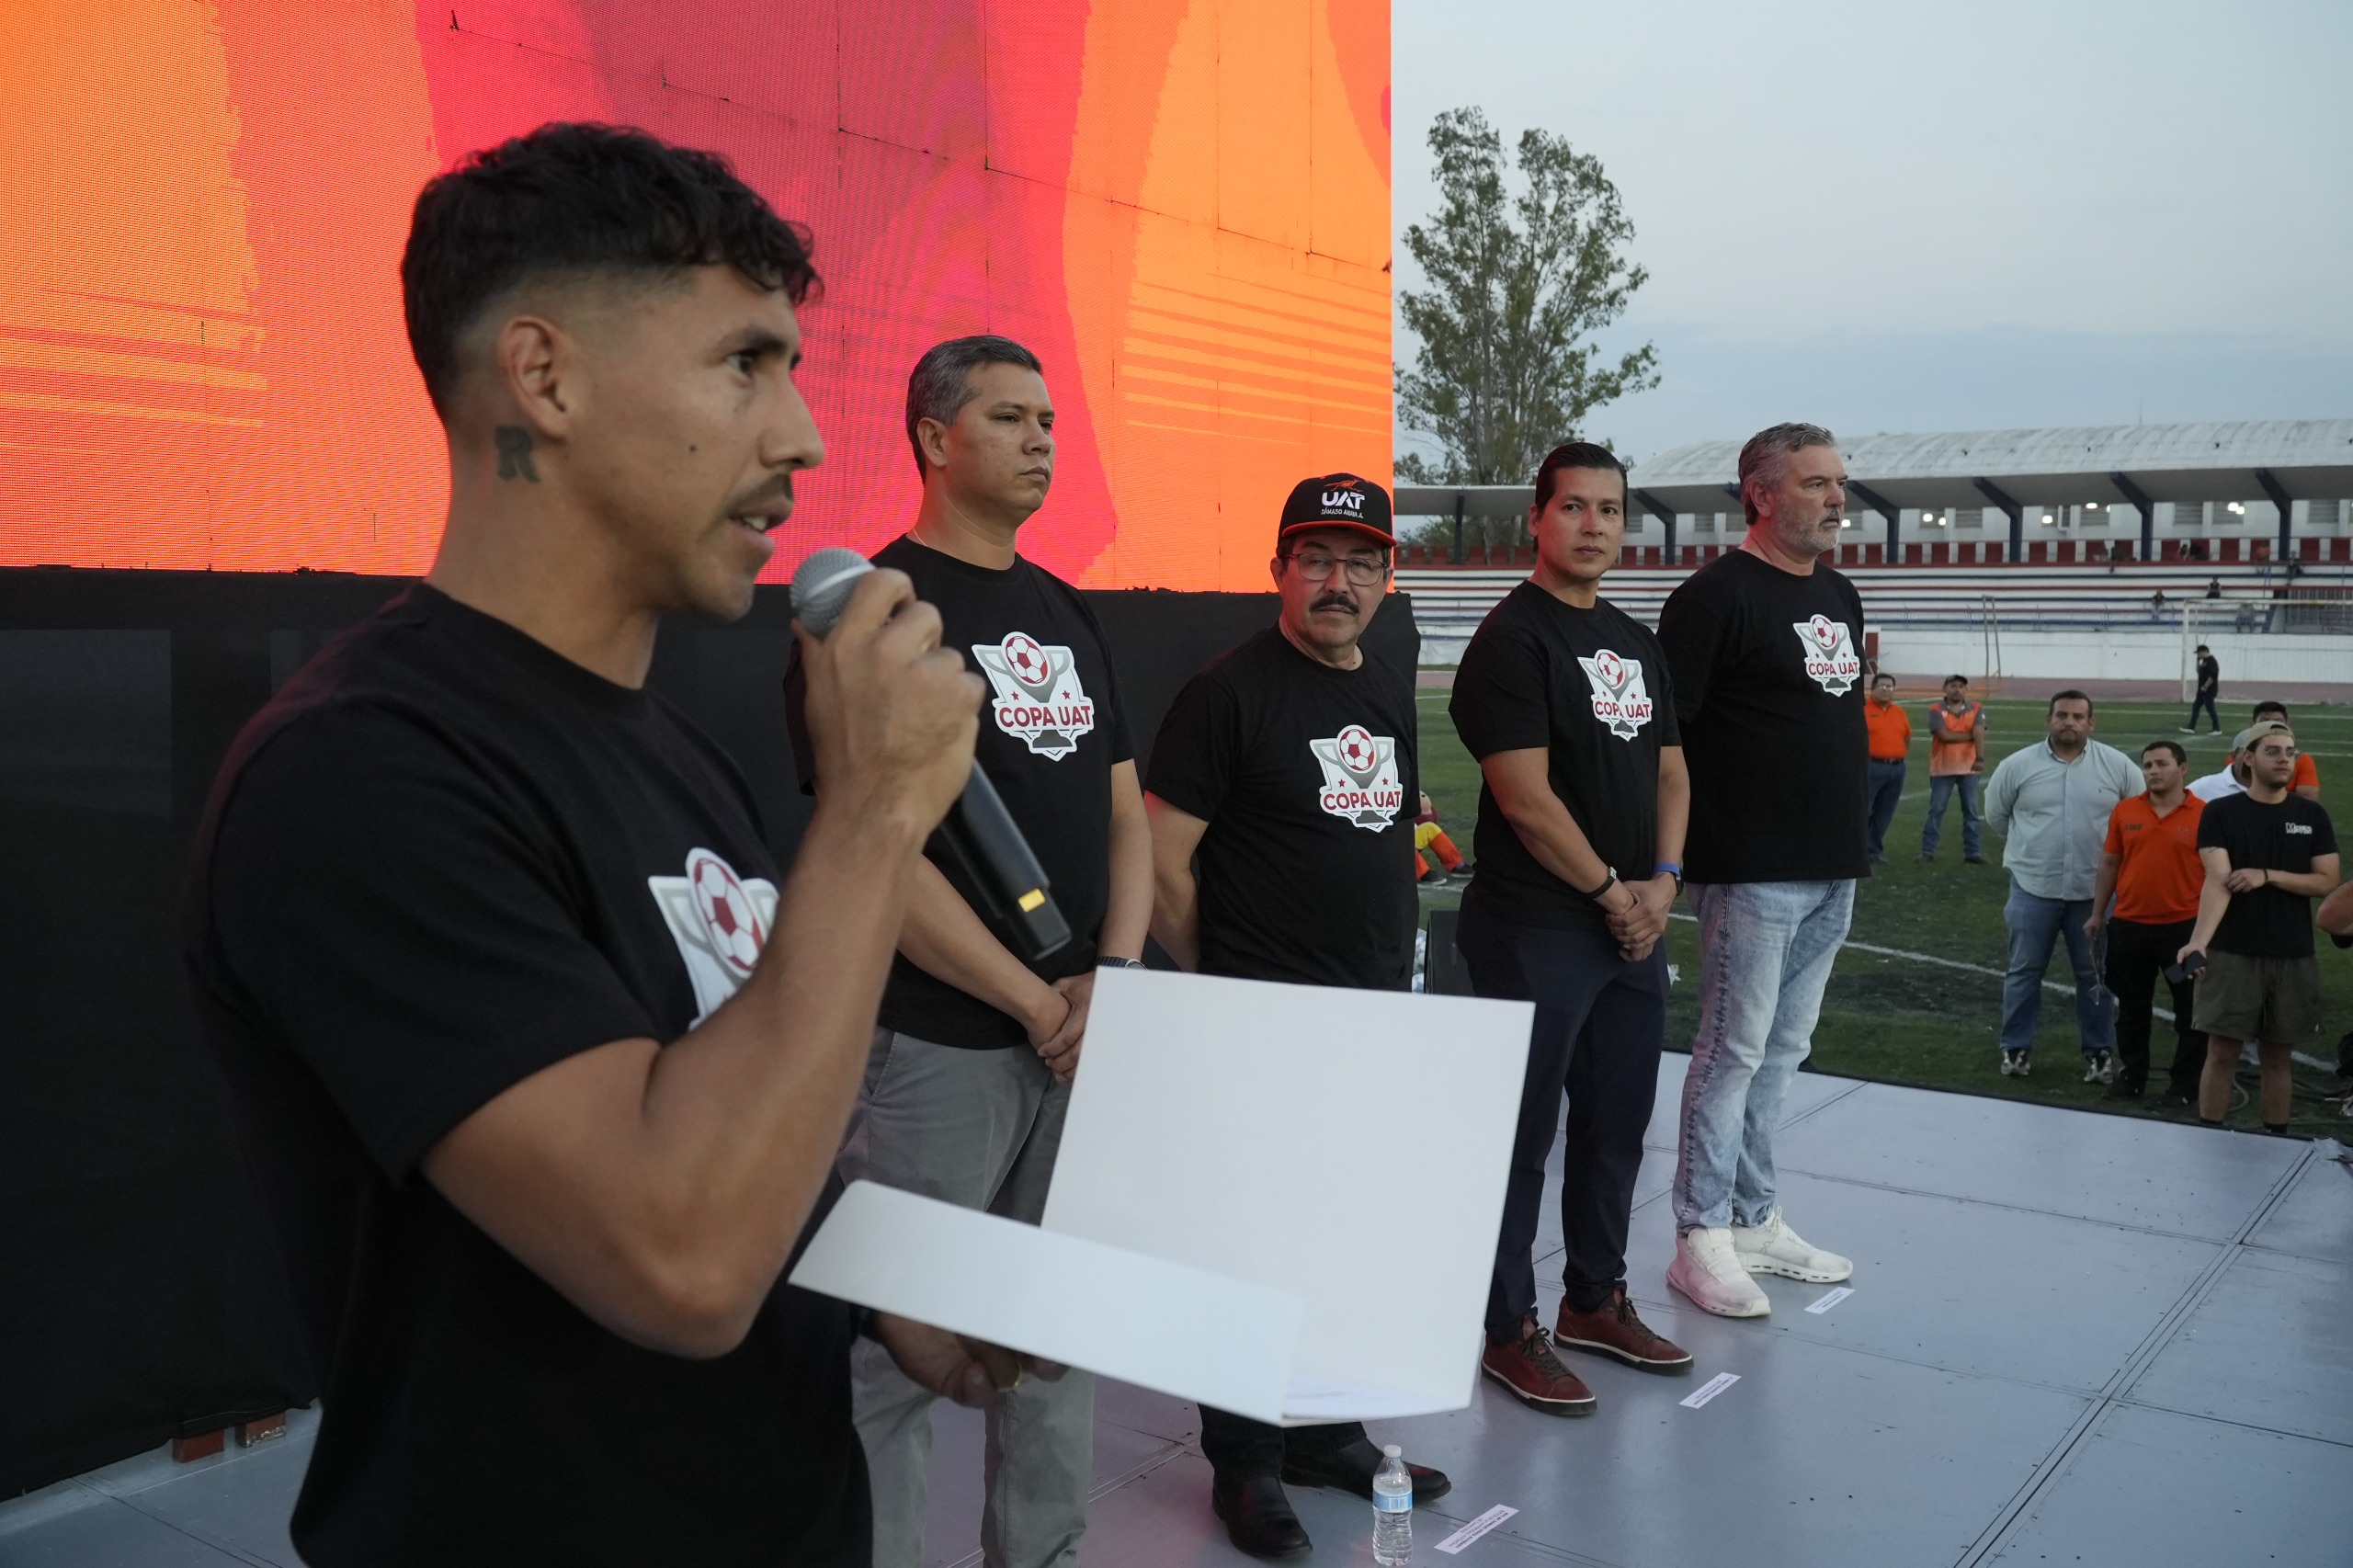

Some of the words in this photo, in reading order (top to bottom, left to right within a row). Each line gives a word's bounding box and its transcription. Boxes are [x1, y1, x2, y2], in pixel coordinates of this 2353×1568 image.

[1321, 491, 1366, 510] UAT
[1321, 506, 1342, 515] DÁMASO
[1808, 663, 1837, 676] COPA
[1838, 662, 1859, 675] UAT
[999, 706, 1057, 728] COPA
[1057, 705, 1091, 726] UAT
[1625, 703, 1650, 719] UAT
[1323, 791, 1373, 811] COPA
[1373, 790, 1401, 808] UAT
